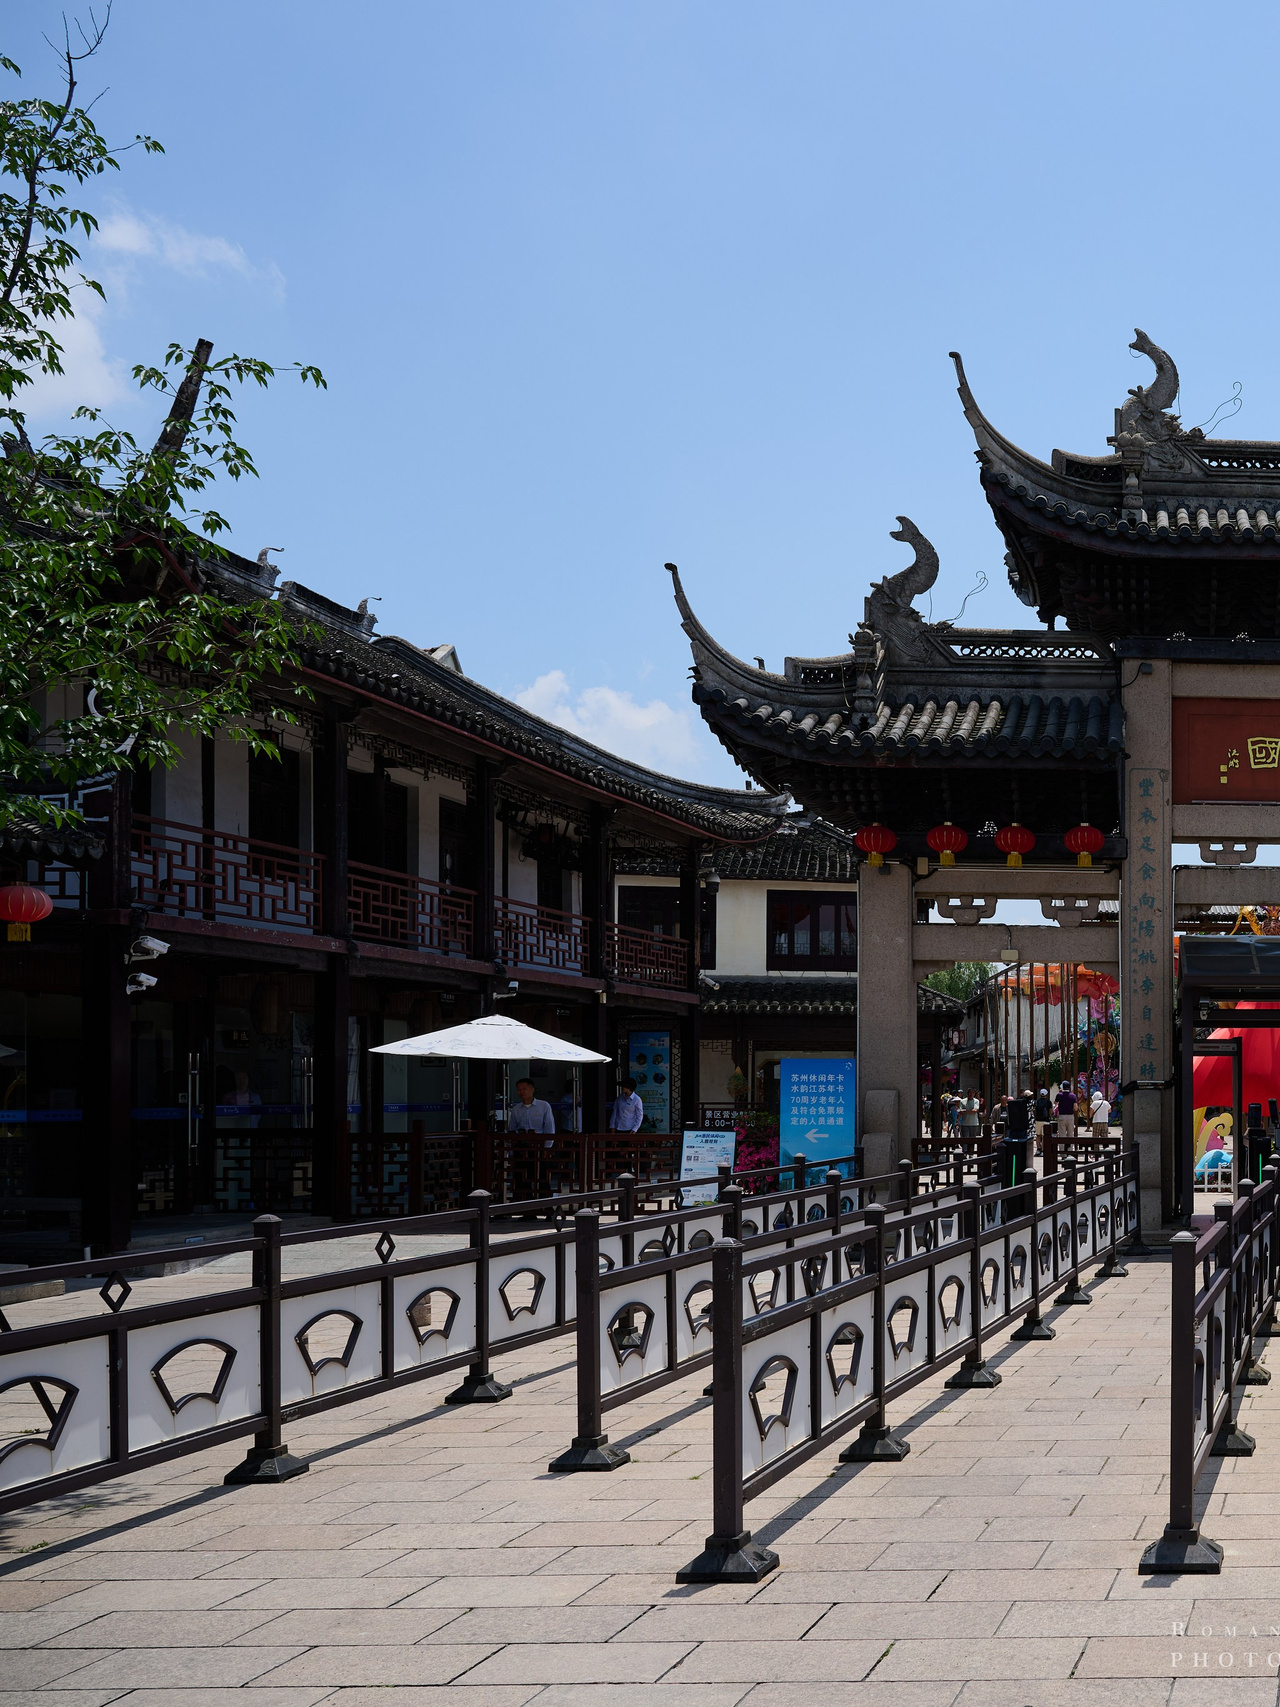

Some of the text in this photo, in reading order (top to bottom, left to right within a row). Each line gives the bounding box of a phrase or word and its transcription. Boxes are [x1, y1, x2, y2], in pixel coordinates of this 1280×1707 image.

[790, 1073, 845, 1083] 苏州休闲年卡
[790, 1084, 845, 1093] 水韵江苏年卡
[790, 1095, 845, 1105] 70周岁老年人
[790, 1106, 845, 1115] 及符合免票规
[790, 1117, 845, 1126] 定的人员通道
